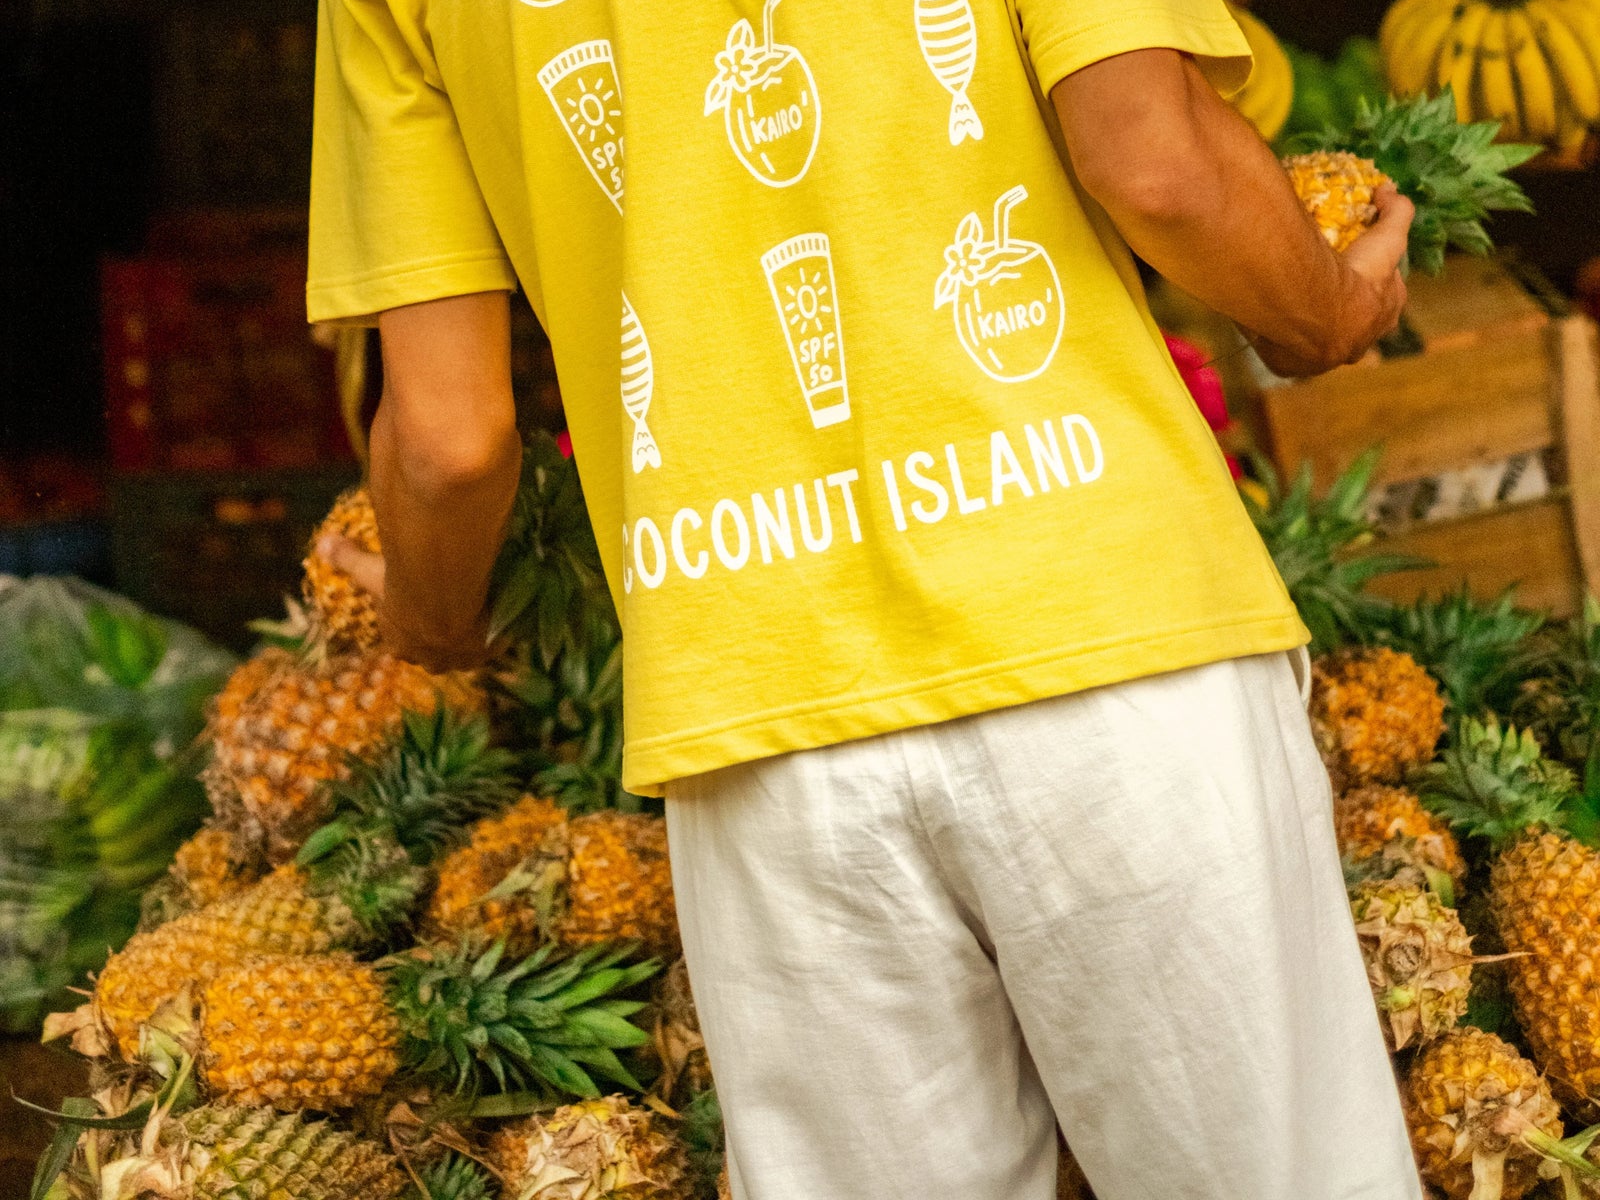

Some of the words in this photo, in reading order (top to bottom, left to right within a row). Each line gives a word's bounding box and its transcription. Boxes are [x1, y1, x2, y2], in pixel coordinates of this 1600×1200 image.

[750, 103, 803, 145] KAIRO
[977, 300, 1046, 339] KAIRO
[799, 332, 835, 364] SPF
[622, 468, 863, 595] COCONUT
[881, 413, 1105, 532] ISLAND
